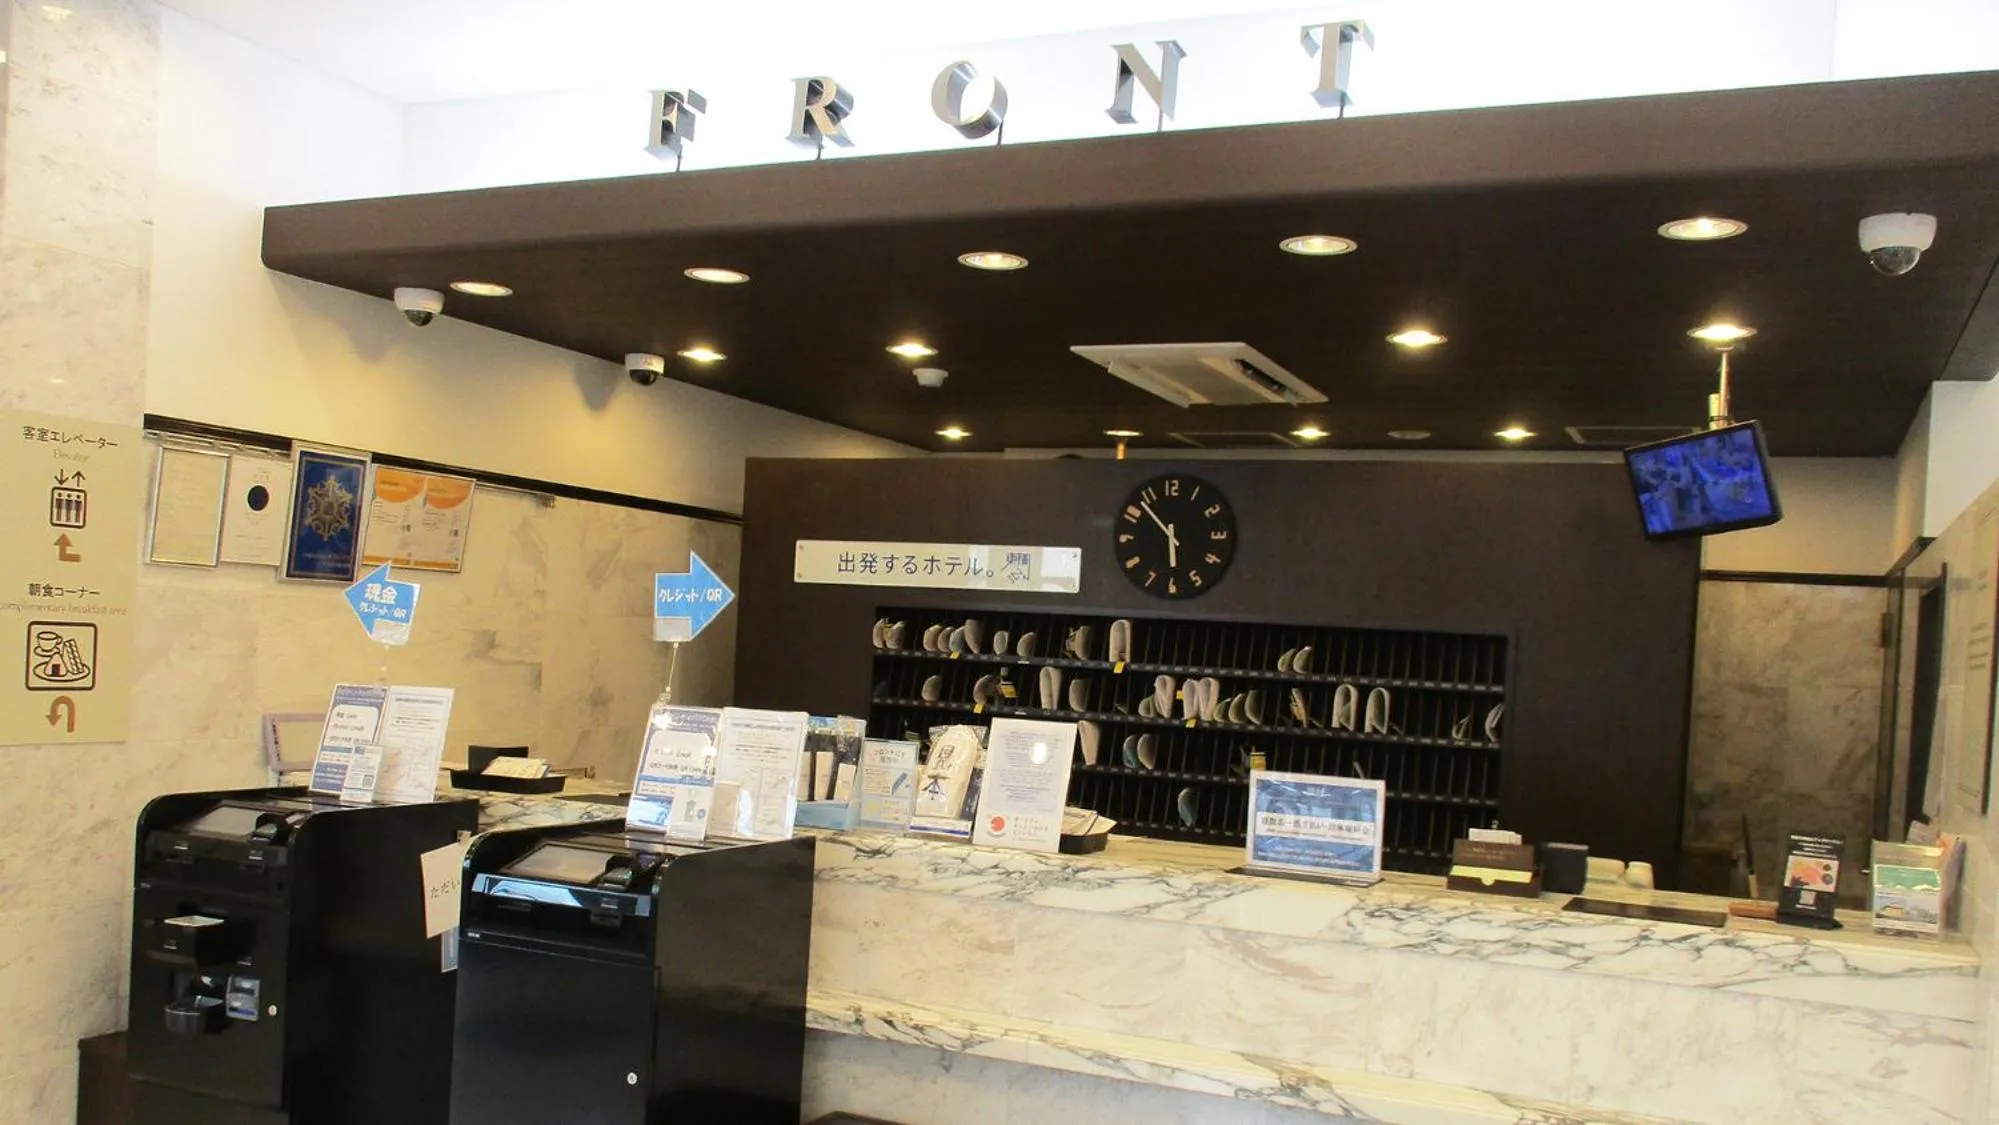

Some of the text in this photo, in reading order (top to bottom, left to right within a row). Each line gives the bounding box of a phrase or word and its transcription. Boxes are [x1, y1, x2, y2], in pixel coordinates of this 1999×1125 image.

[643, 19, 1375, 160] FRONT
[23, 425, 118, 449] 客室エレベーター
[1165, 479, 1179, 496] 12
[1204, 503, 1221, 518] 2
[1210, 530, 1227, 540] 3
[837, 551, 994, 578] 出発するホテル。
[1204, 552, 1222, 564] 4
[1144, 570, 1157, 587] 7
[1168, 576, 1177, 594] 6
[1188, 569, 1202, 587] 5
[28, 583, 100, 598] 朝食コーナー
[364, 583, 398, 604] 現金
[659, 588, 722, 602] クレジット/QR
